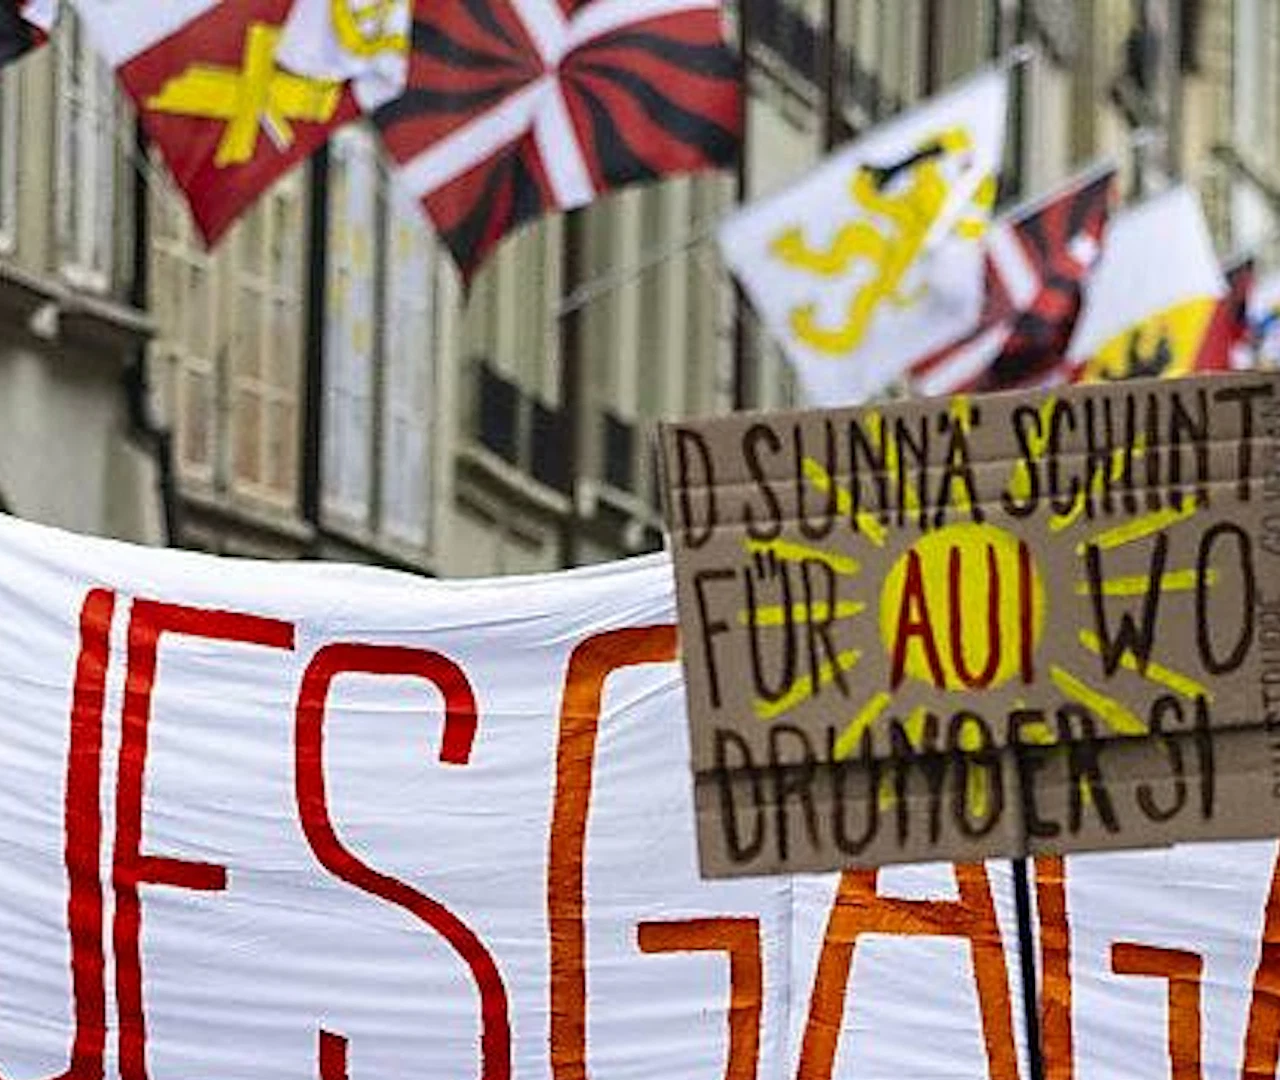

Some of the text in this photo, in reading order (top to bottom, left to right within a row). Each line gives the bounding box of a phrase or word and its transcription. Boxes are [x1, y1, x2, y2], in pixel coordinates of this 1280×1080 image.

[676, 427, 717, 550] D
[741, 405, 987, 542] SUNNÄ
[694, 549, 849, 707] FÜR
[891, 541, 1036, 690] AUI
[1136, 693, 1216, 821] SI
